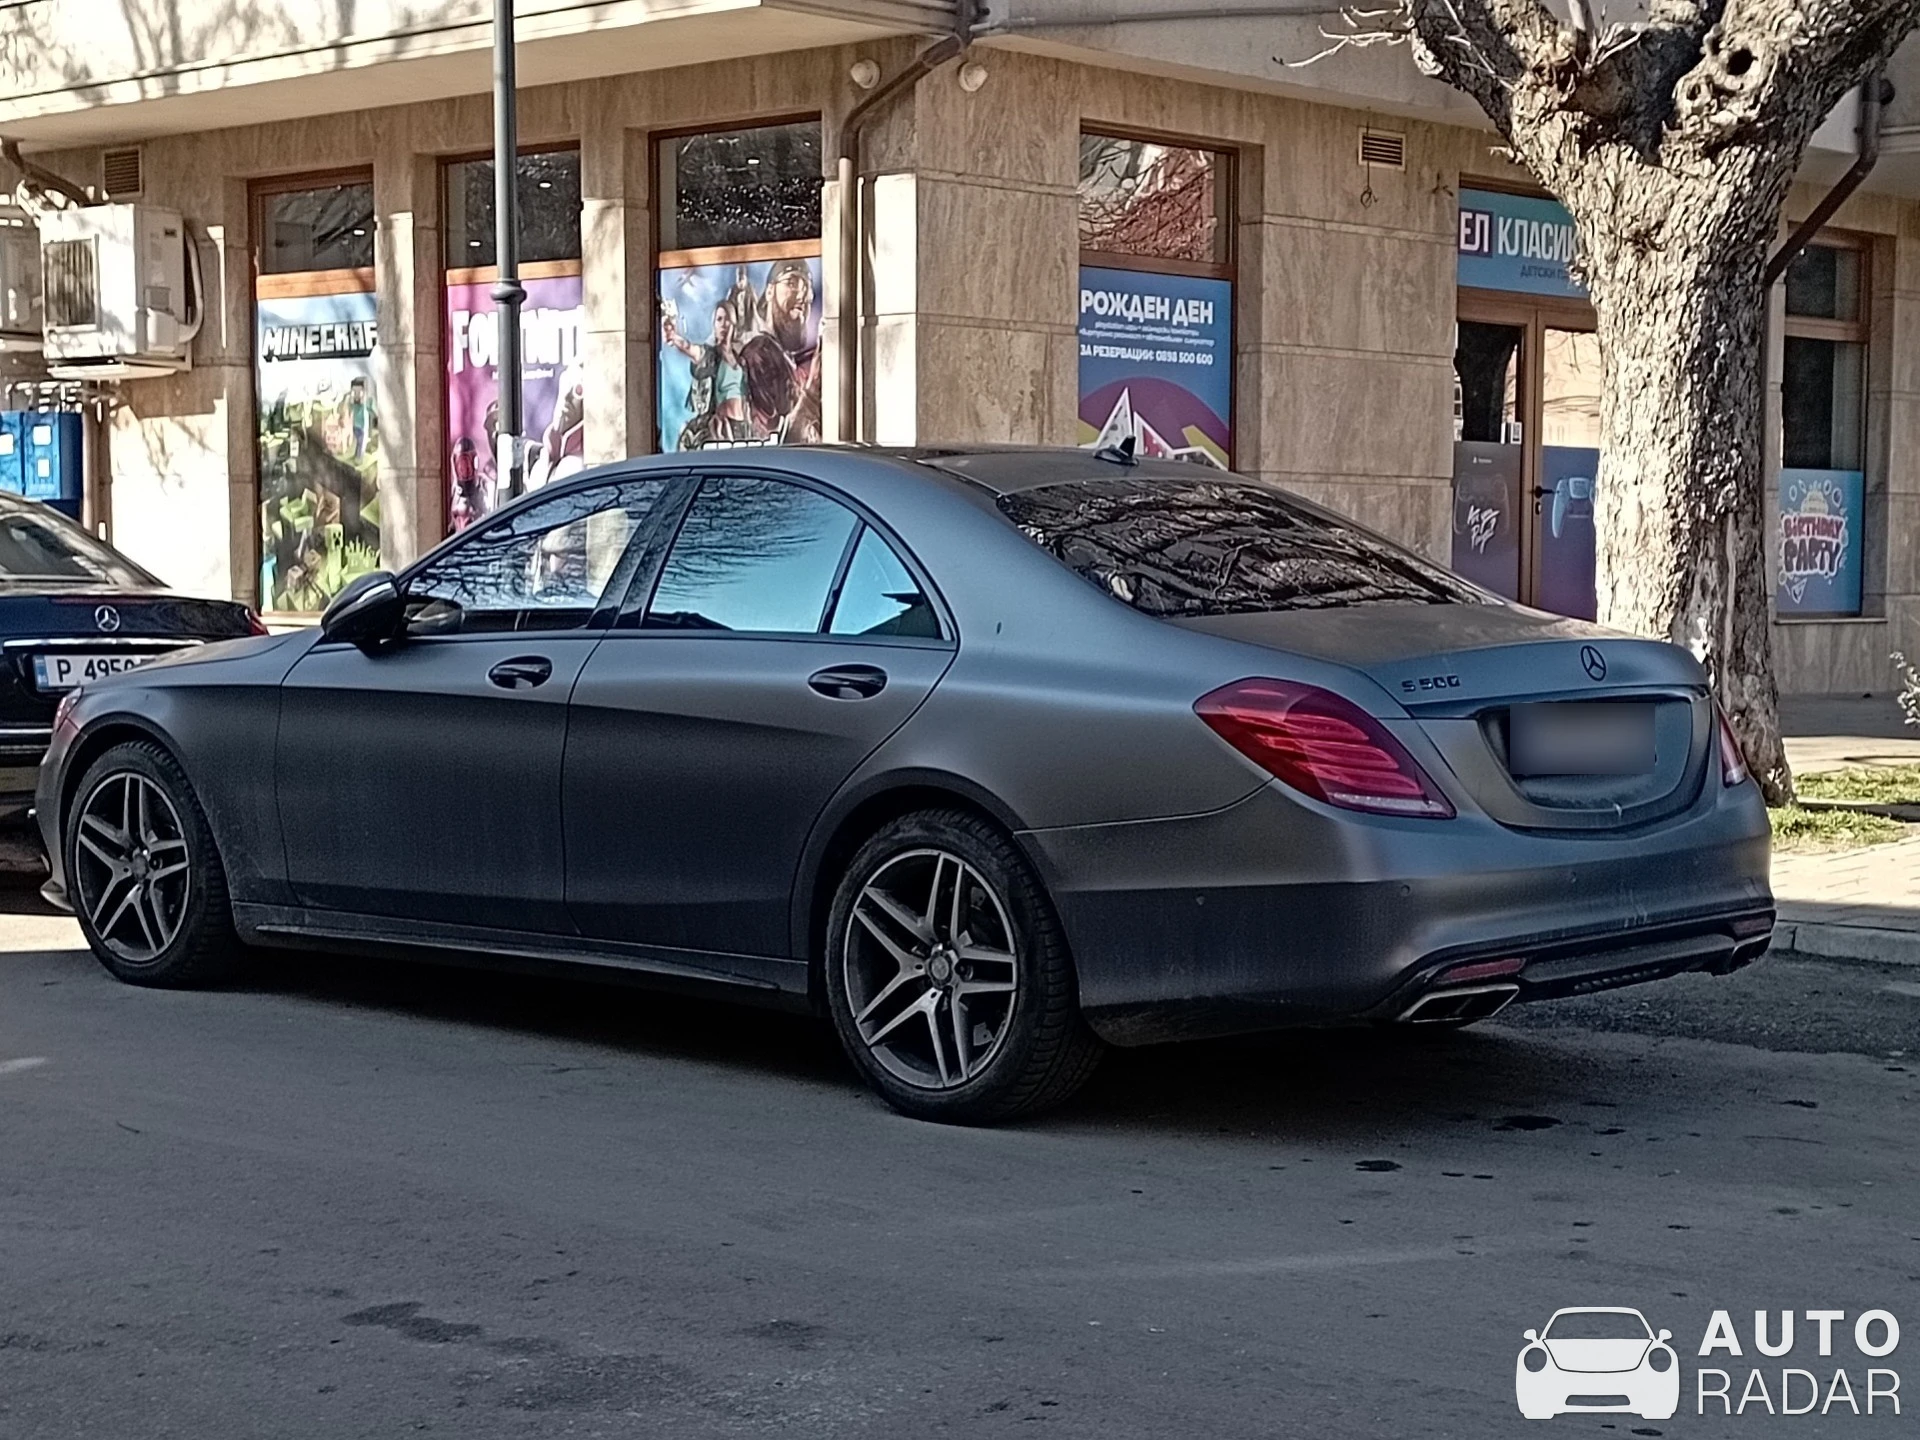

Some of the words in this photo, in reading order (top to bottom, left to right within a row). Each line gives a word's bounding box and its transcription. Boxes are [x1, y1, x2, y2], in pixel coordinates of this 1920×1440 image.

[1460, 211, 1490, 253] ЕЛ
[1081, 289, 1170, 323] РОЖДЕН
[1172, 299, 1213, 327] ДЕН
[1080, 344, 1093, 356] ЗА
[1178, 352, 1196, 364] 500
[1196, 353, 1213, 366] 600
[1782, 537, 1842, 576] PARTY
[57, 659, 71, 682] P
[1401, 680, 1416, 692] S
[1419, 675, 1460, 690] 500
